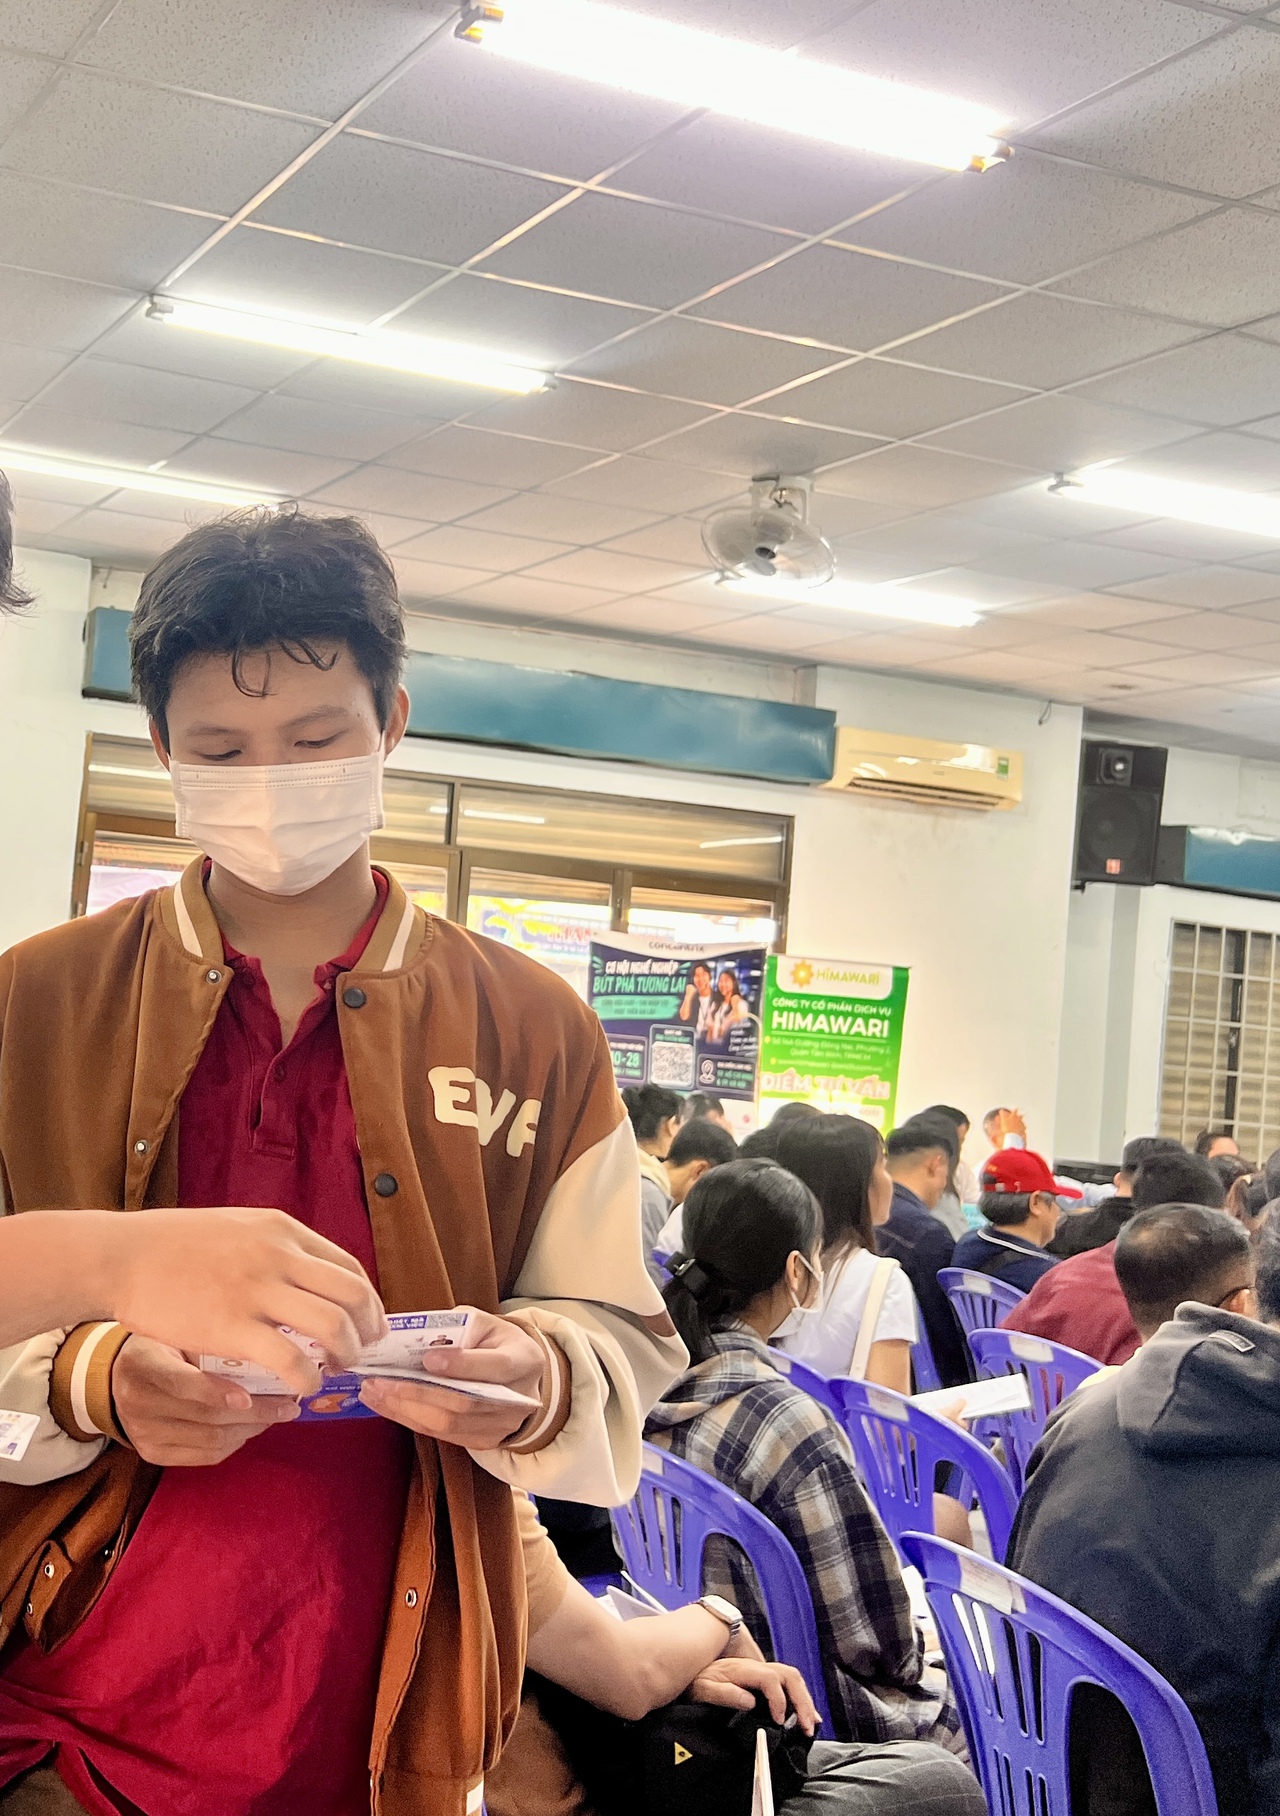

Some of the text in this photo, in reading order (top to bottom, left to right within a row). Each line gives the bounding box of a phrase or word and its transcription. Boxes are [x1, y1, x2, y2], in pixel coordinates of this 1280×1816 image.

[670, 976, 687, 993] LAI
[772, 997, 798, 1009] CÔNG
[800, 1000, 810, 1009] TY
[772, 1010, 889, 1037] HIMAWARI
